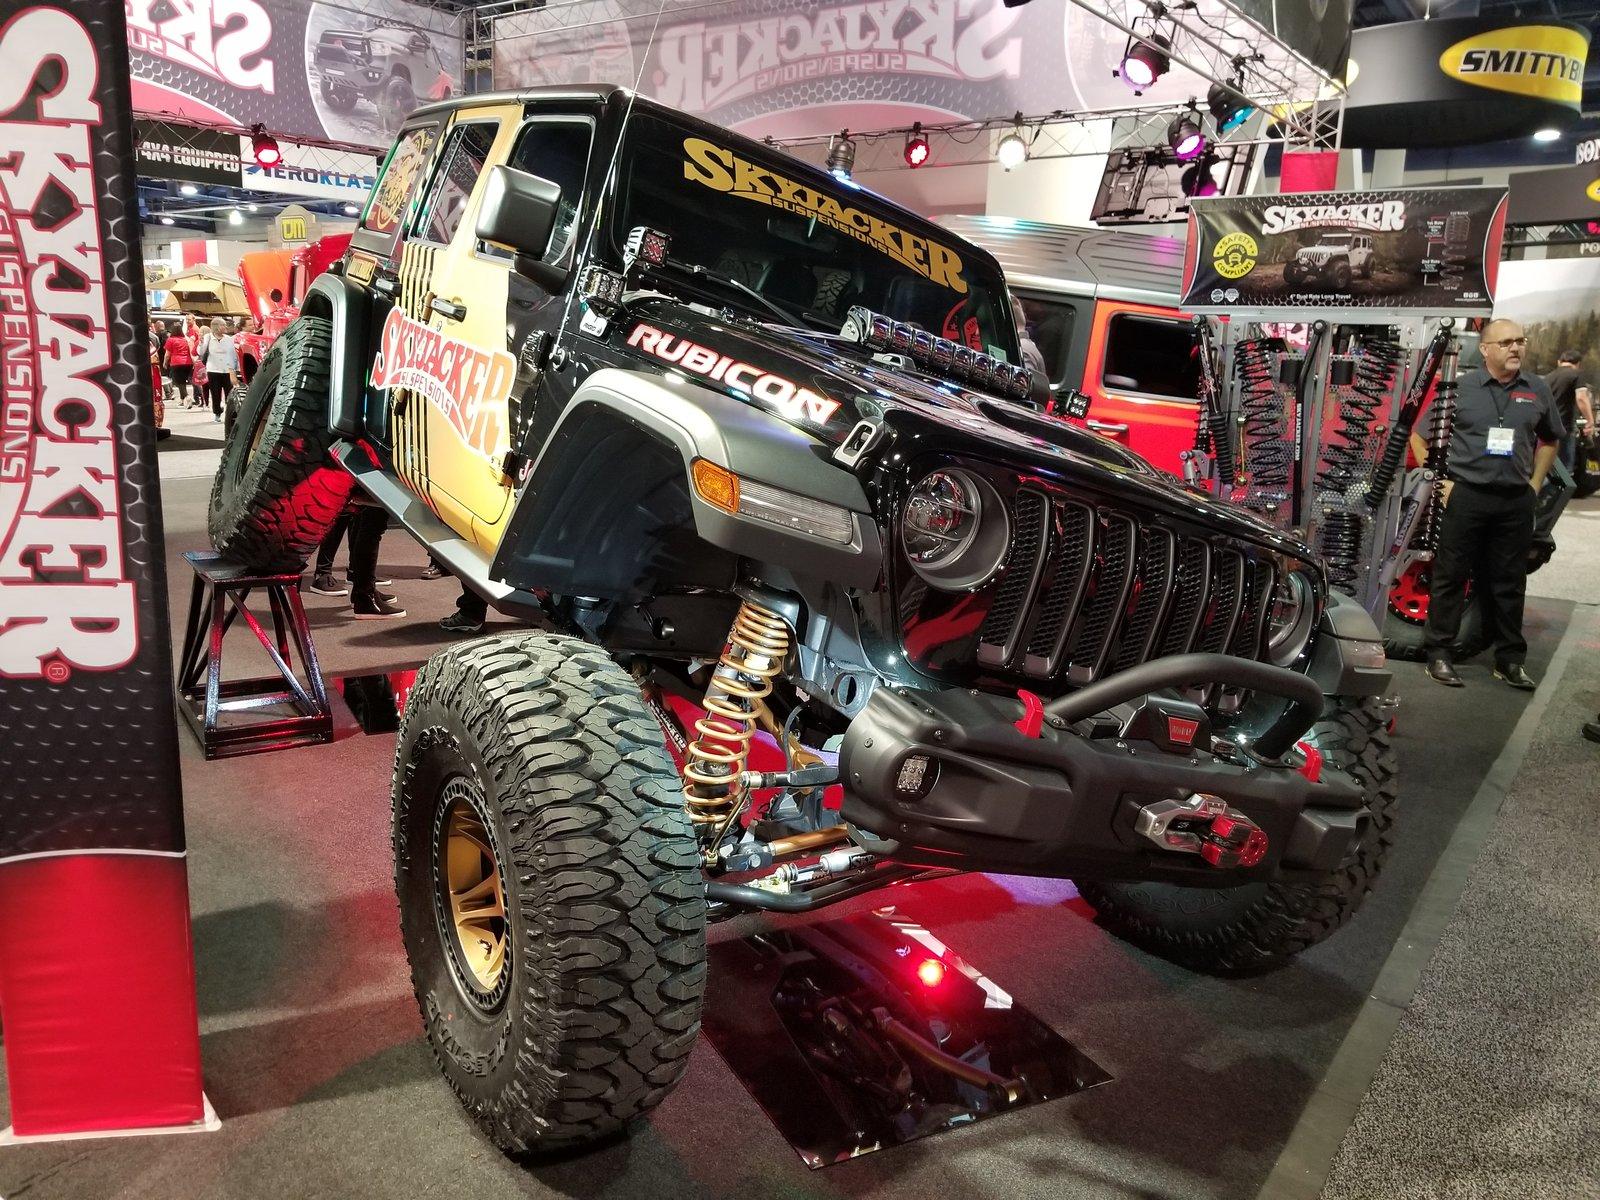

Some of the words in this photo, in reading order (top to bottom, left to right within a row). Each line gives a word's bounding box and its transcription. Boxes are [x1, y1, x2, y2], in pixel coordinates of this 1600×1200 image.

[1459, 49, 1584, 83] SMITTYB
[173, 145, 241, 174] EQUIPPED
[683, 137, 968, 294] SKYJACKER
[770, 196, 890, 255] SUSPENSIONS
[1261, 200, 1405, 235] SKYJACKER
[1216, 261, 1253, 276] COMPLIANT
[0, 6, 137, 675] SKYJACKER
[370, 306, 516, 457] SKYJACKER
[626, 321, 842, 427] RUBICON
